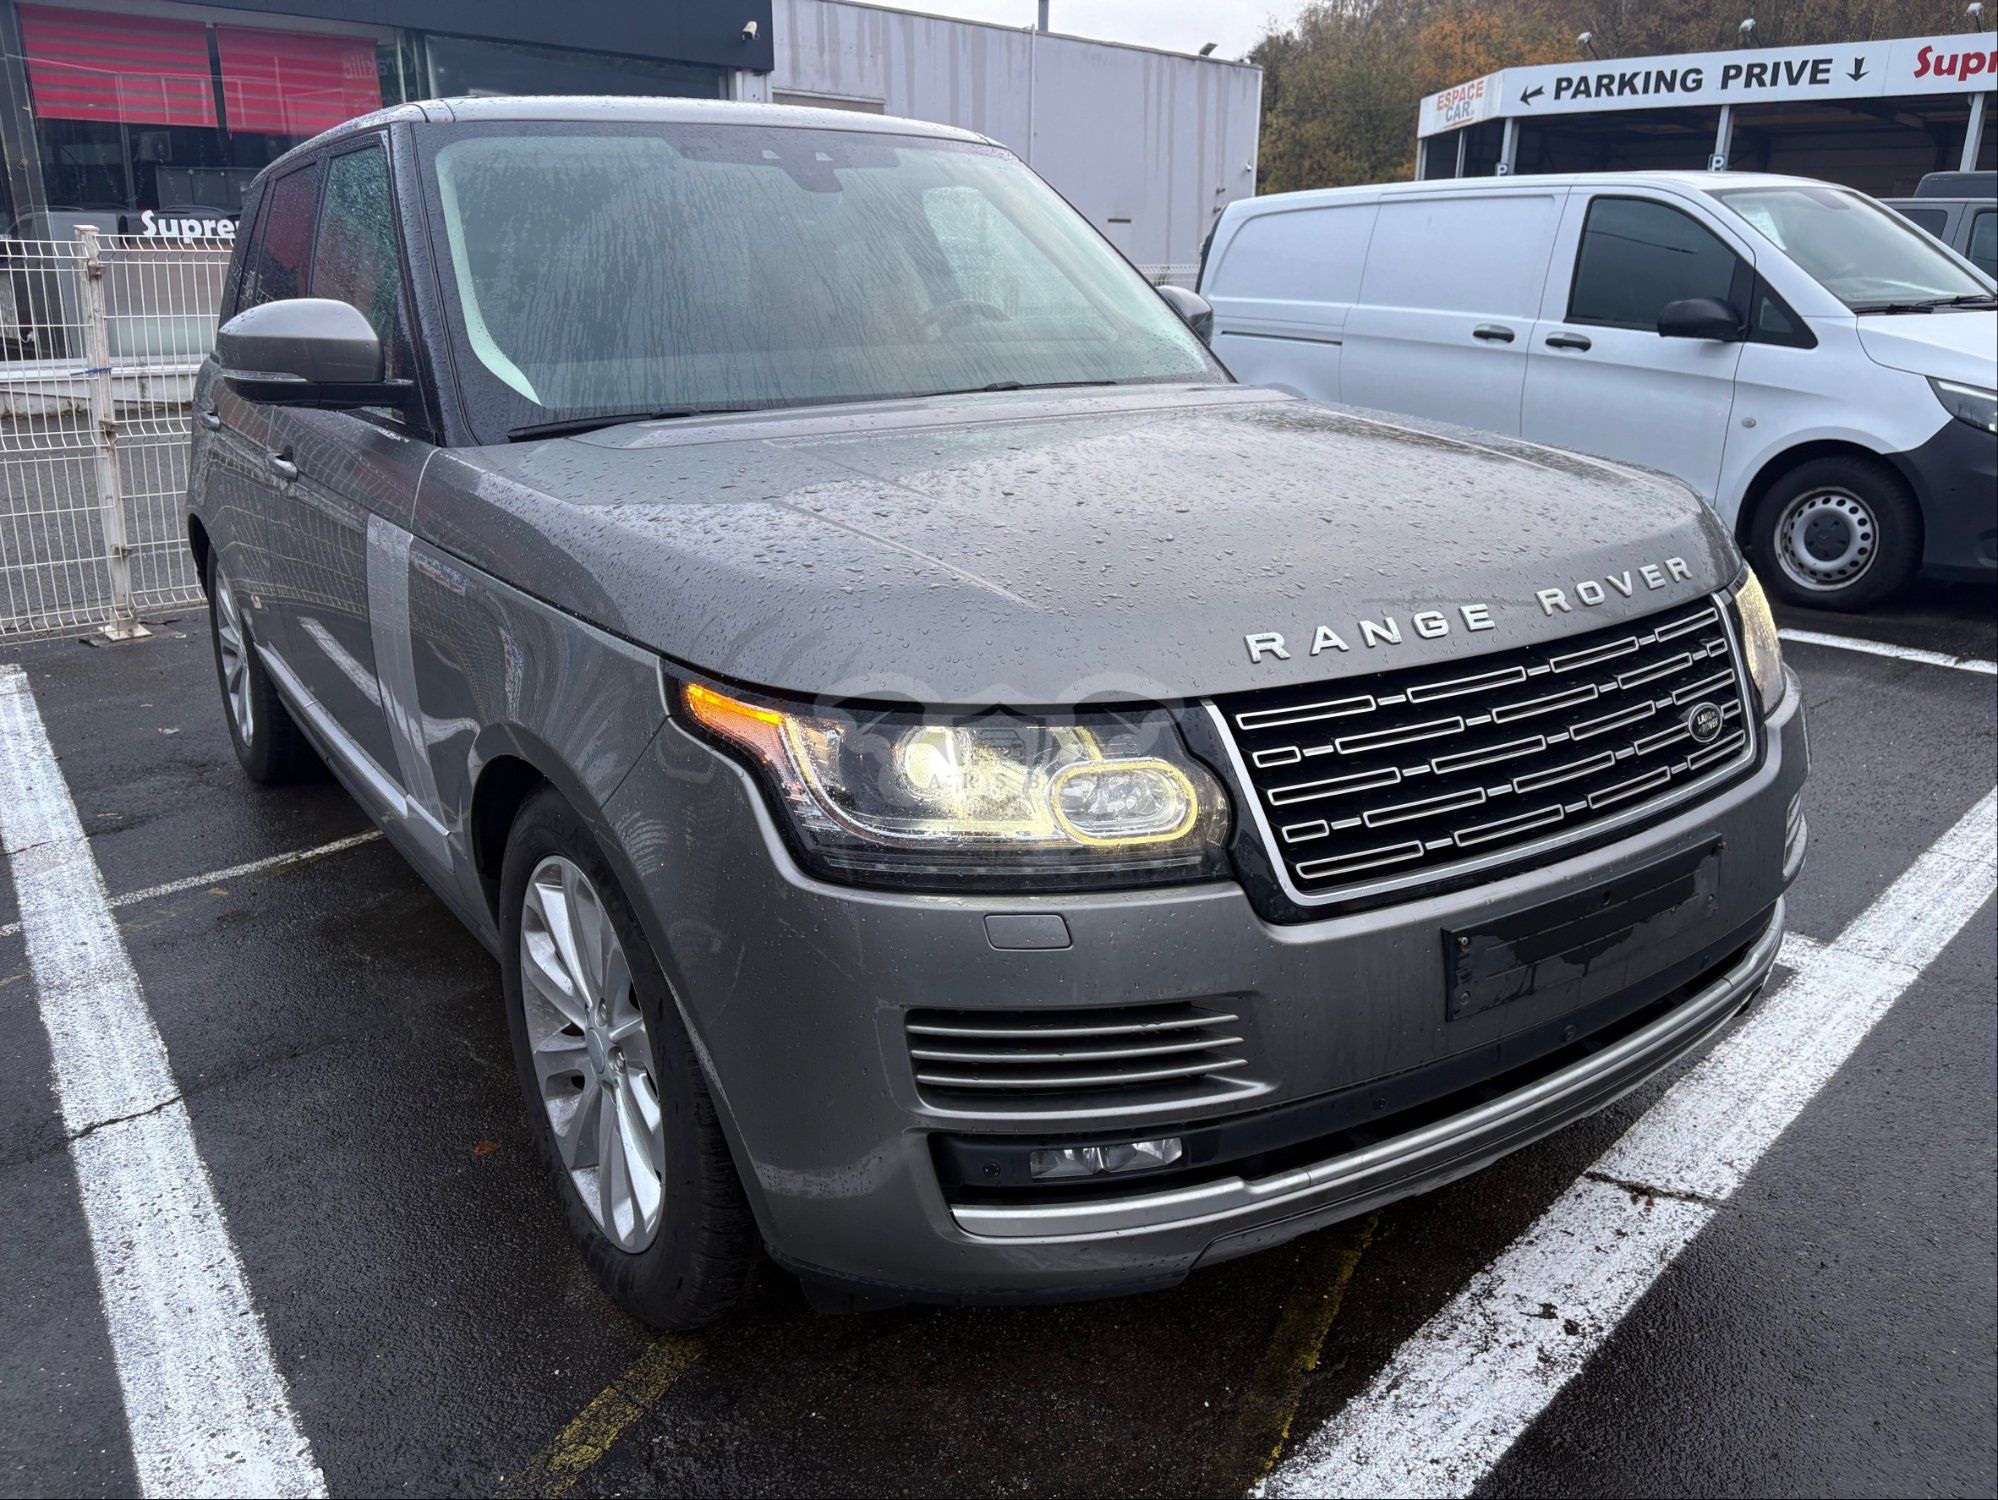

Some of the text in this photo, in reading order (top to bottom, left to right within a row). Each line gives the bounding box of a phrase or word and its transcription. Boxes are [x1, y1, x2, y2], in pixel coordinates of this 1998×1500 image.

[1436, 80, 1484, 111] ESPACE
[1553, 58, 1833, 101] PARKING PRIVE
[1497, 164, 1508, 176] P
[1712, 156, 1724, 172] P
[141, 210, 239, 243] Supre
[1245, 556, 1693, 663] RANGE ROVER
